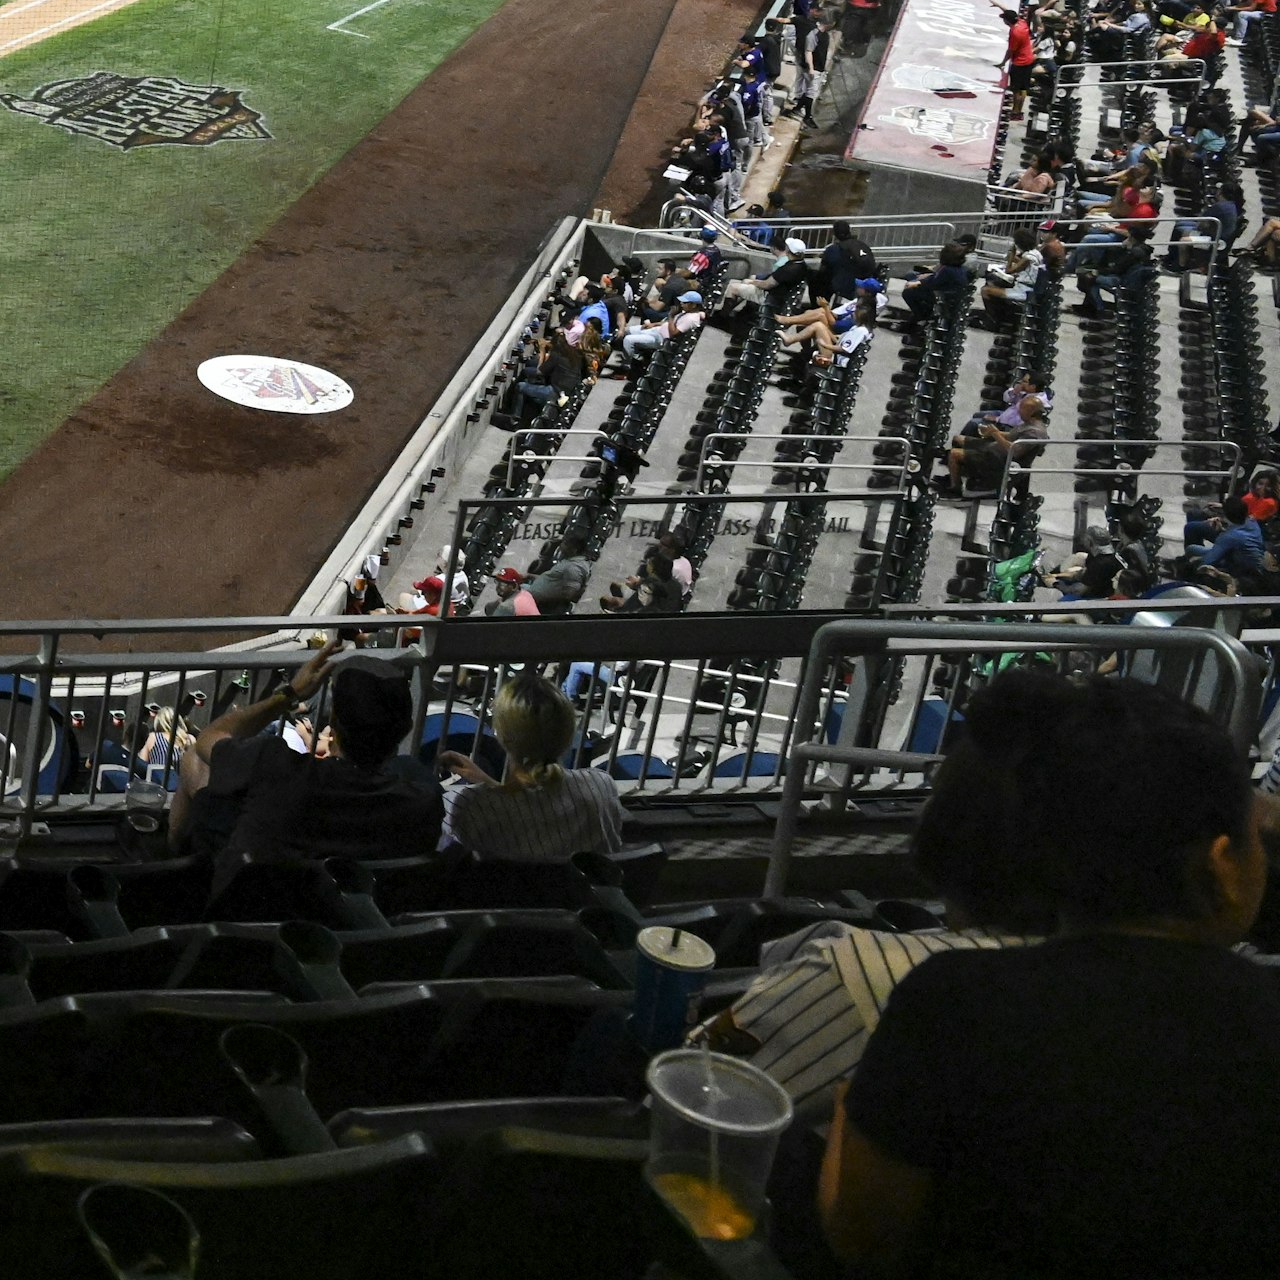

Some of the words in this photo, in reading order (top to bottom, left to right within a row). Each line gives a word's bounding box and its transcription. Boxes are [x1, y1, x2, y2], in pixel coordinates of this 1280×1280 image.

[513, 522, 563, 540] LEASE
[630, 520, 663, 538] LEA
[713, 518, 752, 536] LASS
[826, 516, 852, 533] AIL
